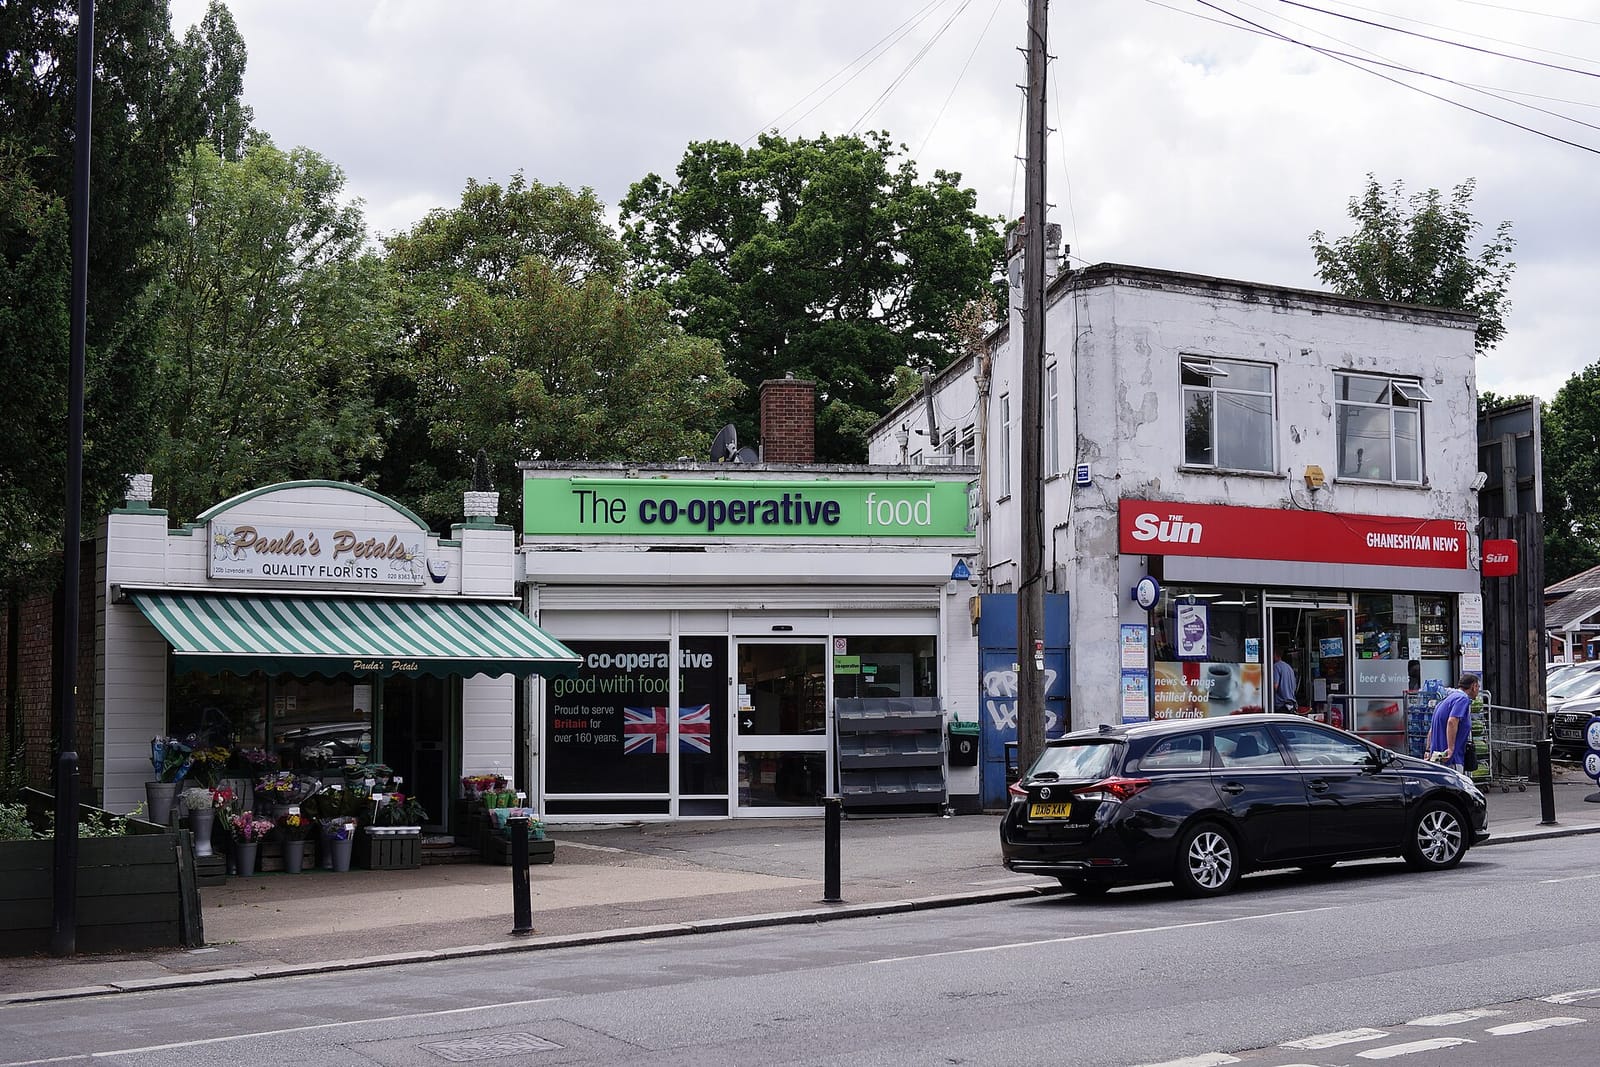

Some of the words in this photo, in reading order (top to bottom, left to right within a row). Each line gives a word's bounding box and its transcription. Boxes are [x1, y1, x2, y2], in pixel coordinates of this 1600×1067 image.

[572, 490, 626, 524] The
[638, 492, 841, 532] co-operative
[865, 492, 932, 526] food
[1168, 514, 1184, 522] THE
[1131, 513, 1203, 544] Sun
[1453, 521, 1466, 531] 122
[232, 525, 321, 556] Paula's
[333, 530, 407, 560] Petals
[1366, 532, 1431, 551] GHANESHYAM
[1432, 536, 1459, 552] NEWS
[1485, 553, 1509, 563] Sun
[262, 563, 315, 577] QUALITY
[1321, 641, 1342, 651] OPEN
[353, 660, 385, 671] Paula's
[391, 660, 418, 671] Petals
[587, 649, 713, 672] co-operative
[1154, 677, 1181, 686] news
[1180, 674, 1188, 686] &
[1190, 677, 1215, 688] mags
[1359, 672, 1378, 683] beer
[1380, 672, 1386, 683] &
[554, 674, 596, 698] good
[599, 674, 634, 693] with
[1154, 691, 1185, 702] chilled
[1187, 691, 1210, 703] food
[554, 704, 579, 715] Proud
[581, 705, 590, 715] to
[591, 706, 615, 715] serve
[1154, 707, 1173, 719] soft
[1175, 707, 1204, 719] drinks
[554, 719, 588, 729] Britain
[590, 718, 602, 729] for
[554, 734, 572, 743] over
[575, 732, 592, 743] 160
[593, 734, 619, 745] years.
